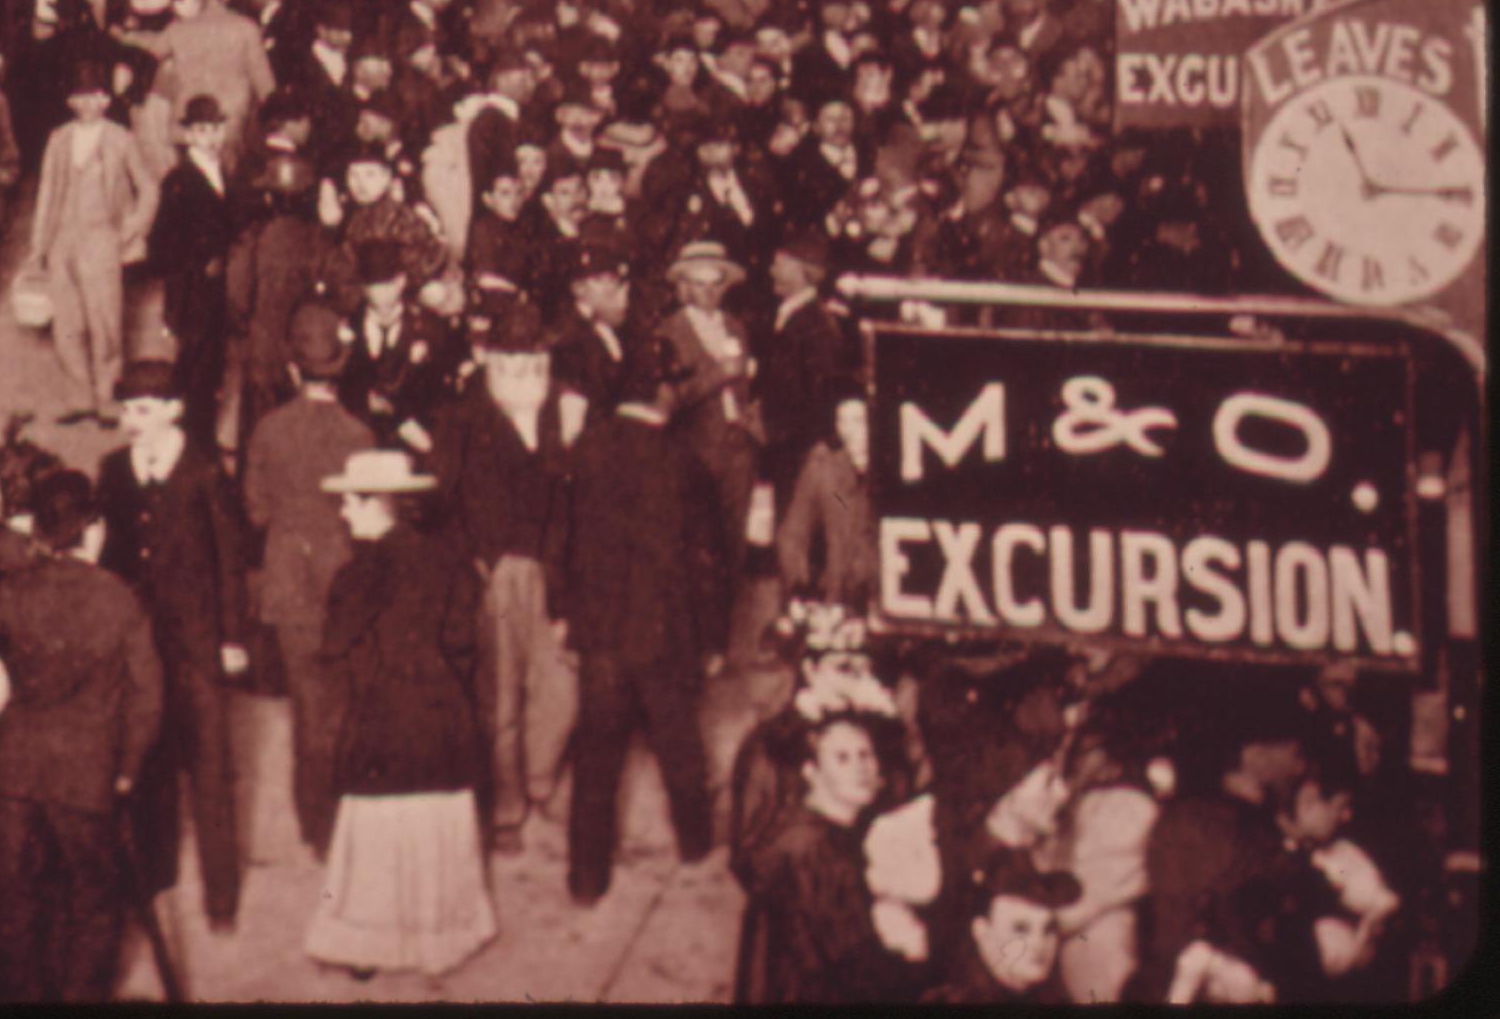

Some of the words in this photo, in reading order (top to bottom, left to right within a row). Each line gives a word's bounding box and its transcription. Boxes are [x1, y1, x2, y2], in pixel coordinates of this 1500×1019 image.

[1249, 19, 1454, 105] LEAVES
[900, 381, 1005, 482] M
[1052, 375, 1179, 457] &
[880, 516, 1416, 656] EXCURSION.
